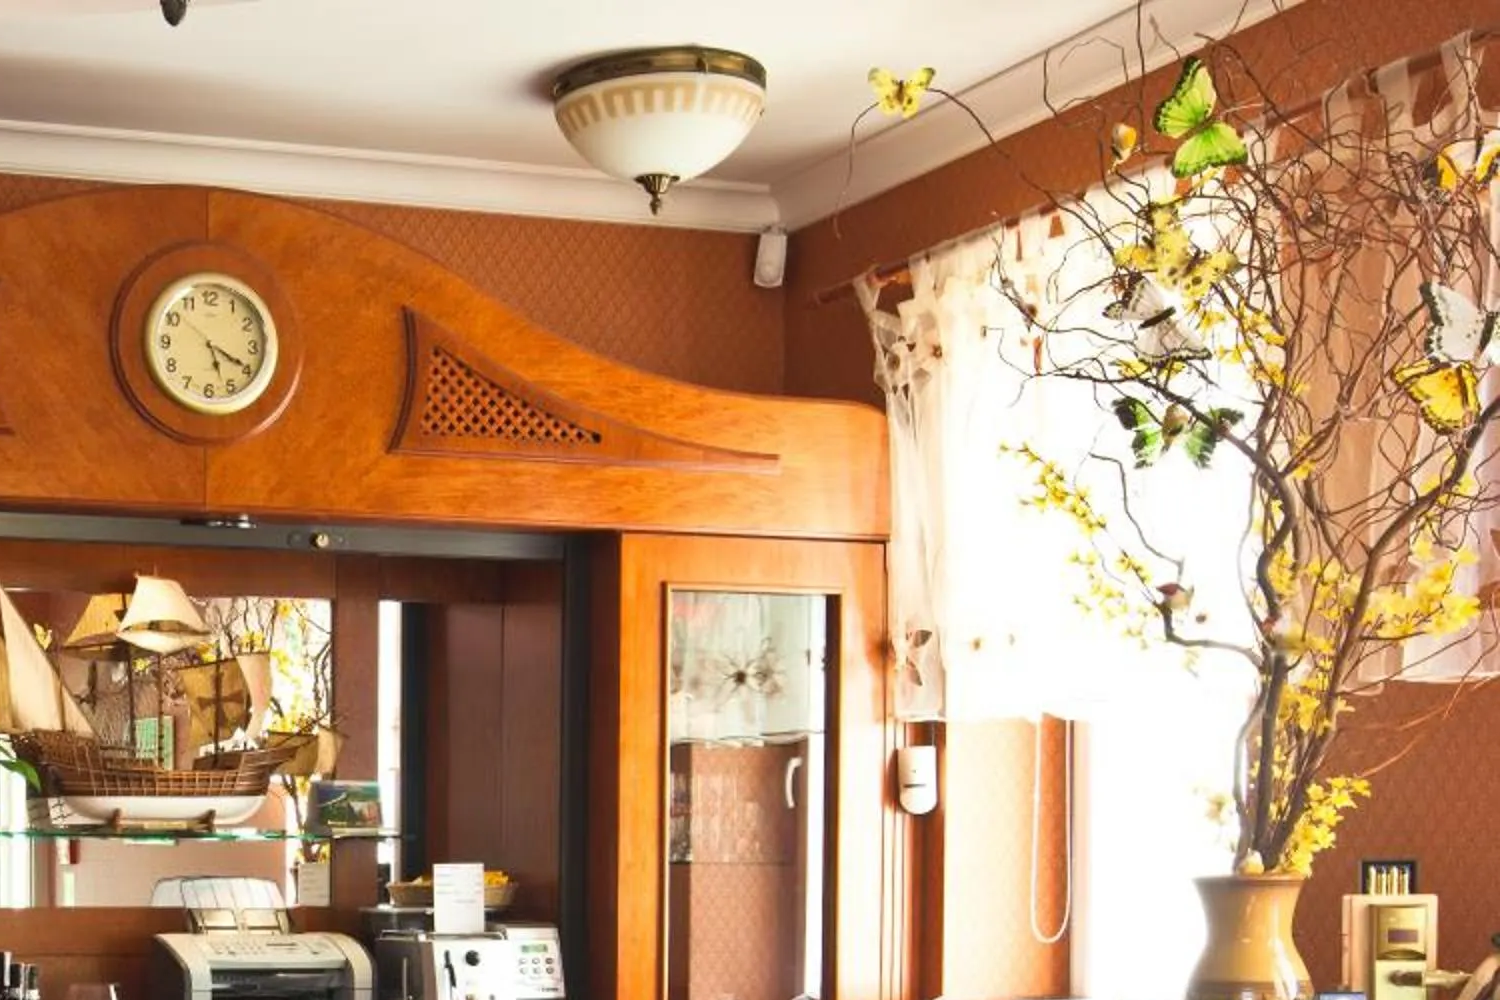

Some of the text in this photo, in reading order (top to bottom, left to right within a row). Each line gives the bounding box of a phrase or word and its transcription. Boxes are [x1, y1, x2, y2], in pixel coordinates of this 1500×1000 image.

[182, 297, 195, 310] 11
[202, 291, 219, 307] 12
[165, 311, 180, 327] 10
[242, 317, 253, 332] 2
[160, 335, 171, 350] 9
[247, 339, 259, 355] 3
[165, 358, 177, 372] 8
[241, 364, 252, 378] 4
[181, 375, 192, 389] 7
[225, 379, 237, 394] 5
[203, 383, 214, 398] 6
